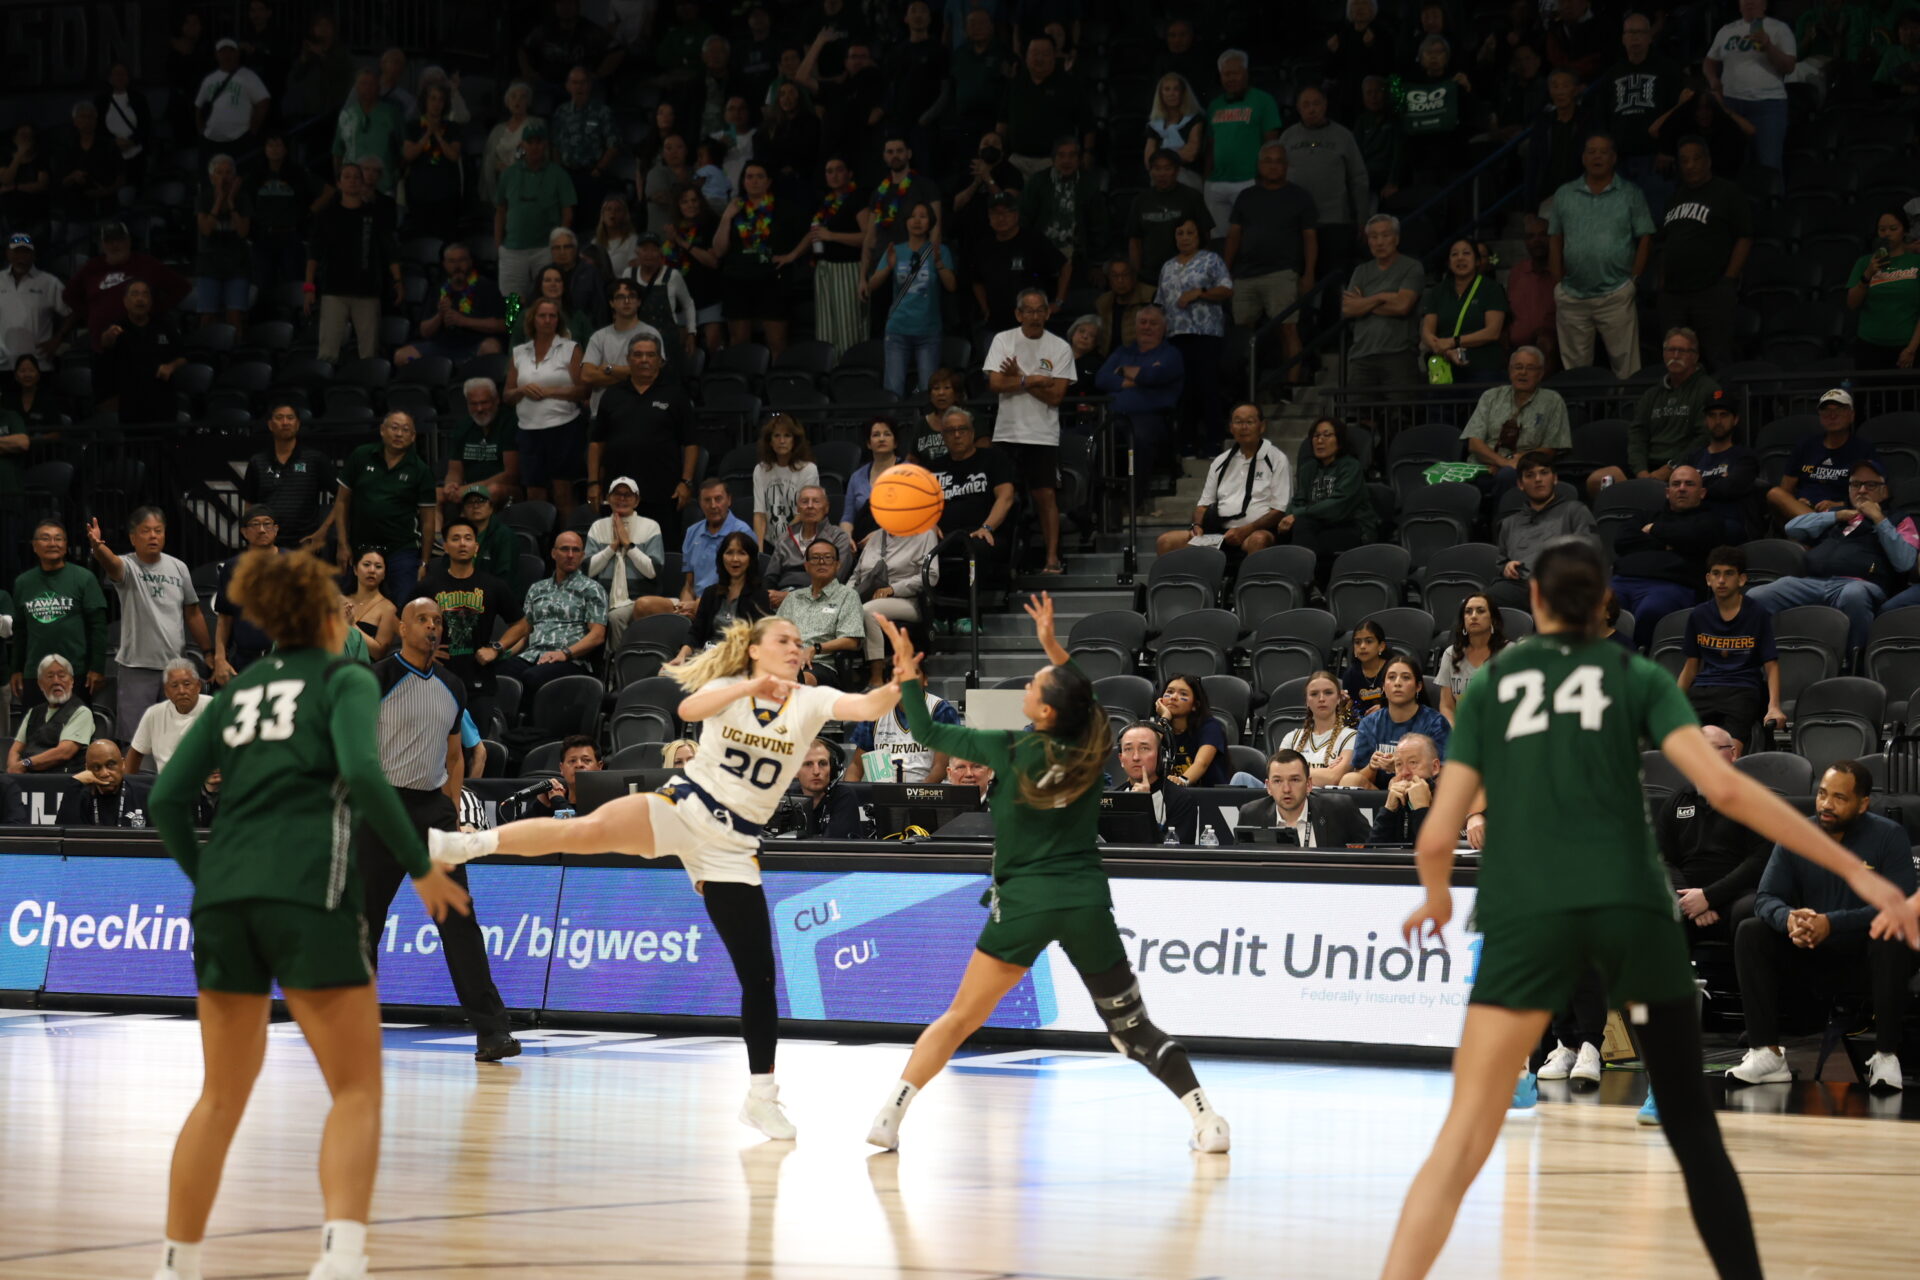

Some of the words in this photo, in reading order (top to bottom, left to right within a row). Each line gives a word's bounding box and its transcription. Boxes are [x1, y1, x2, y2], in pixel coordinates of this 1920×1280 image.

[1407, 88, 1446, 105] GO
[1408, 100, 1445, 112] BOWS
[1816, 467, 1849, 477] IRVINE
[1697, 633, 1757, 649] ANTEATERS
[222, 679, 306, 748] 33
[1496, 664, 1613, 743] 24
[722, 725, 743, 743] UC
[743, 733, 794, 755] IRVINE
[719, 747, 782, 790] 20
[9, 899, 195, 959] Checkin
[794, 898, 841, 932] CU1
[833, 936, 879, 970] CU1
[1284, 931, 1453, 984] Union
[1300, 988, 1361, 1006] Federally
[1365, 989, 1417, 1005] insured
[1419, 991, 1438, 1008] by
